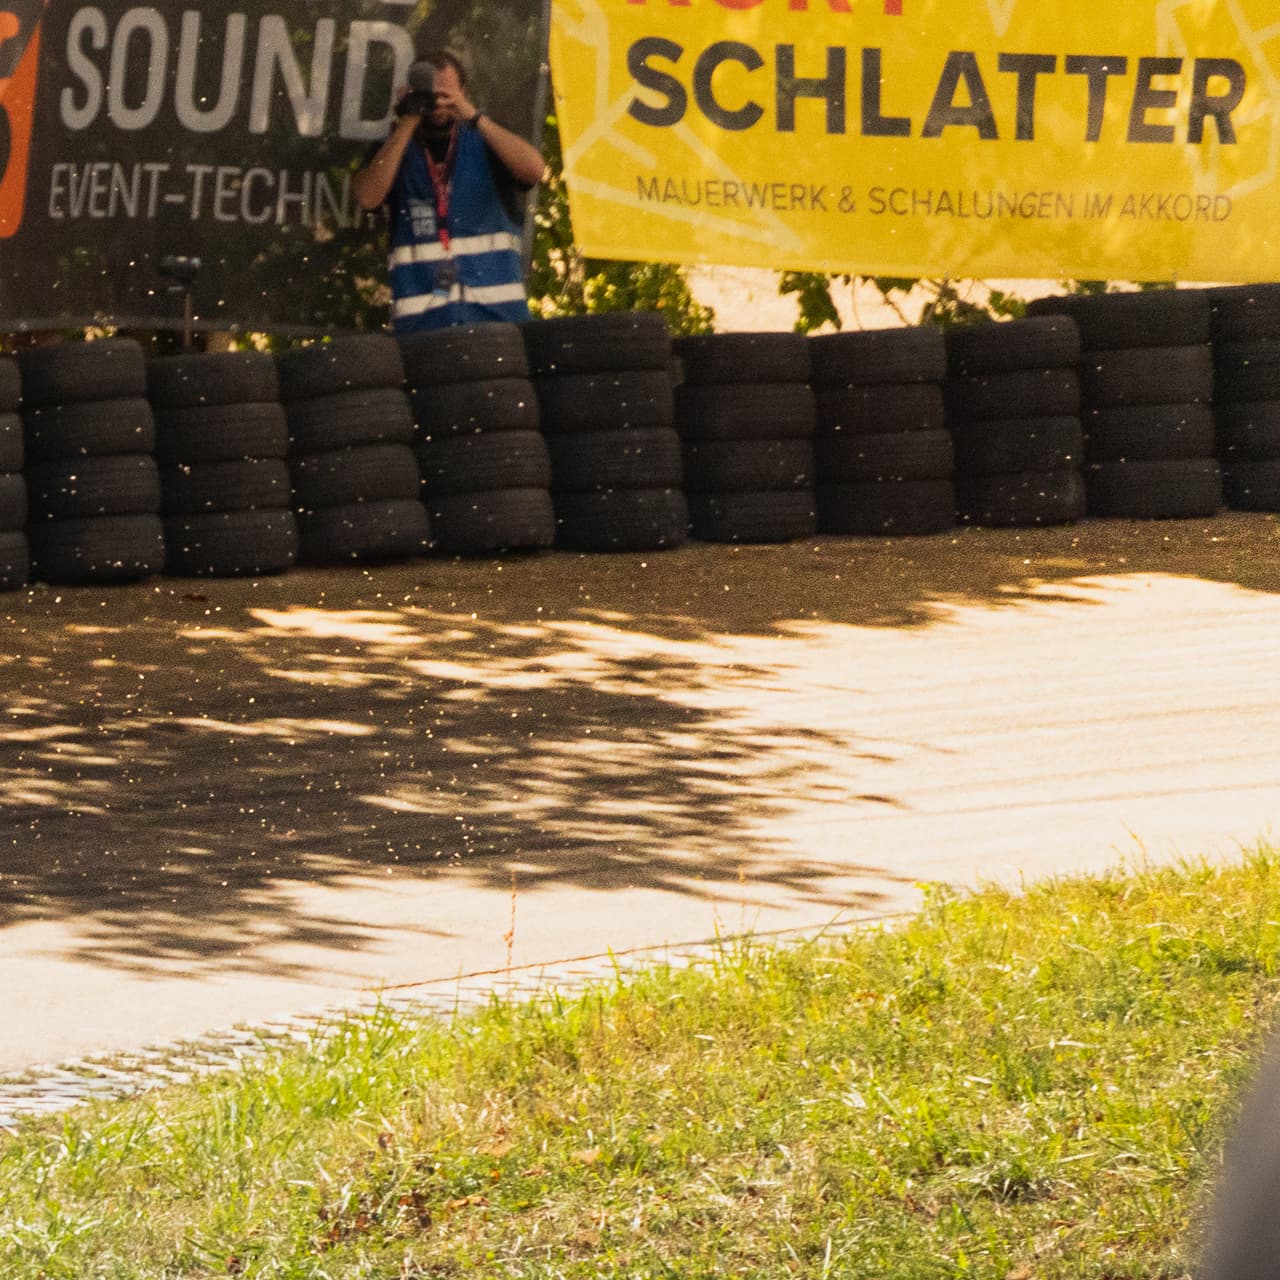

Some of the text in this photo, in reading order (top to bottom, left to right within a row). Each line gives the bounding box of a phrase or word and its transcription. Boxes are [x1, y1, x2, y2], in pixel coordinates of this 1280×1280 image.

[61, 6, 416, 141] SOUND
[626, 36, 1247, 145] SCHLATTER
[48, 162, 378, 229] EVENT-TECHN
[636, 175, 1233, 222] MAUERWERK & SCHALUNGEN IM AKKORD
